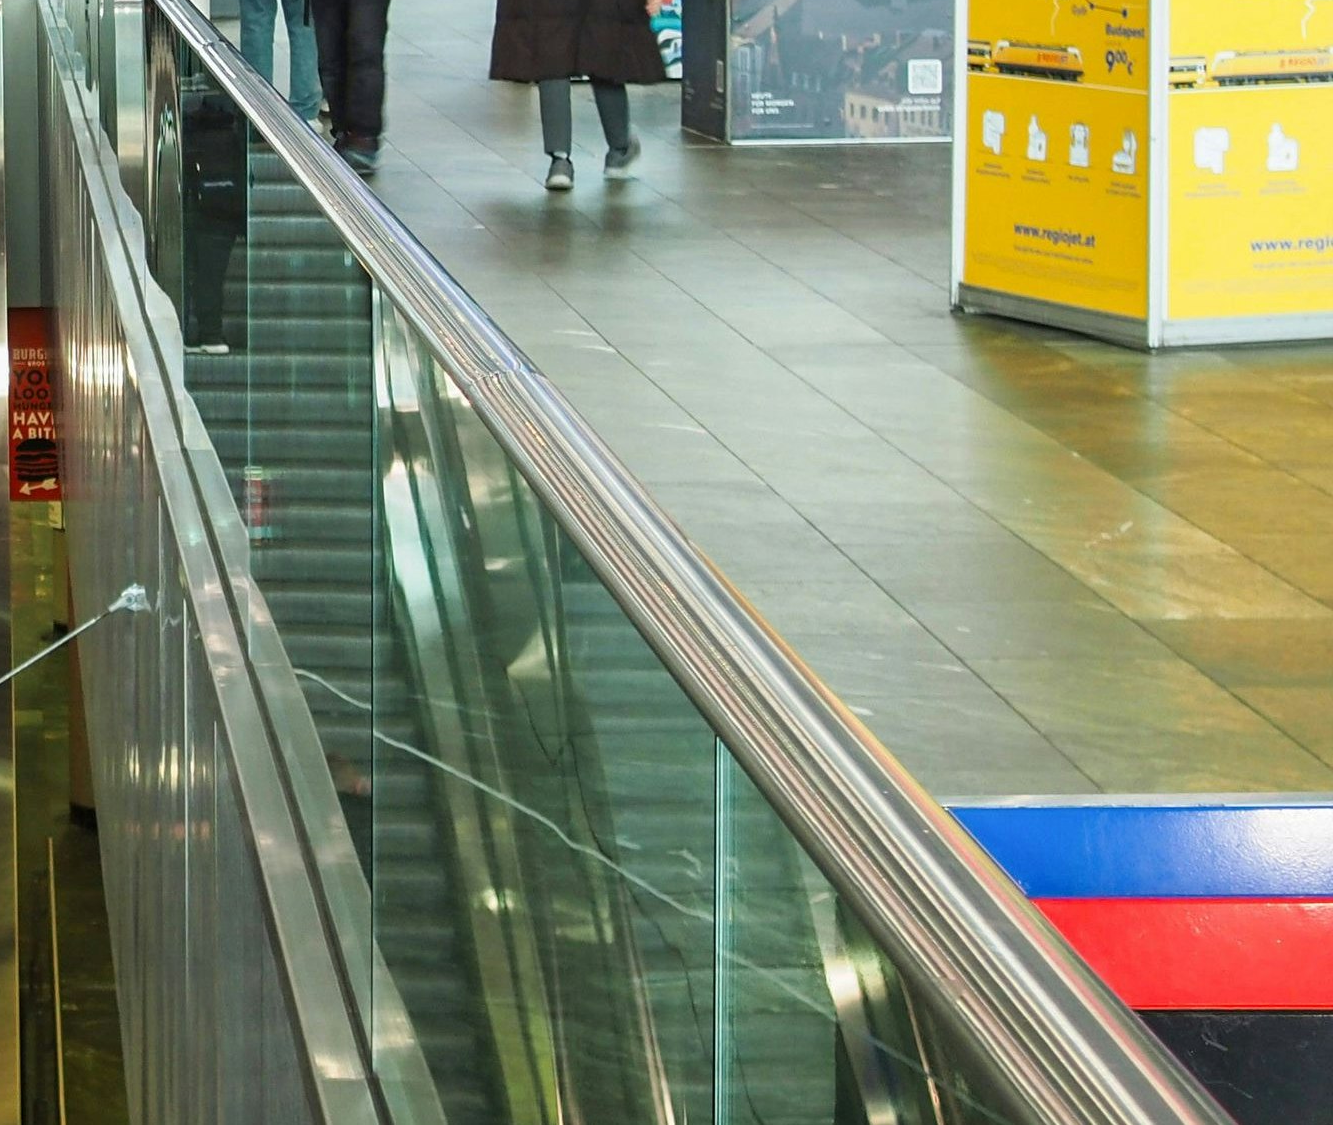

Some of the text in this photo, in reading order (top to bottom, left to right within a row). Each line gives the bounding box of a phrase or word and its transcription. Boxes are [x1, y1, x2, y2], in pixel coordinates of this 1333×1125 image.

[1105, 23, 1146, 39] Budapest
[1013, 223, 1096, 249] www.regiojet.at
[12, 348, 47, 361] BURG
